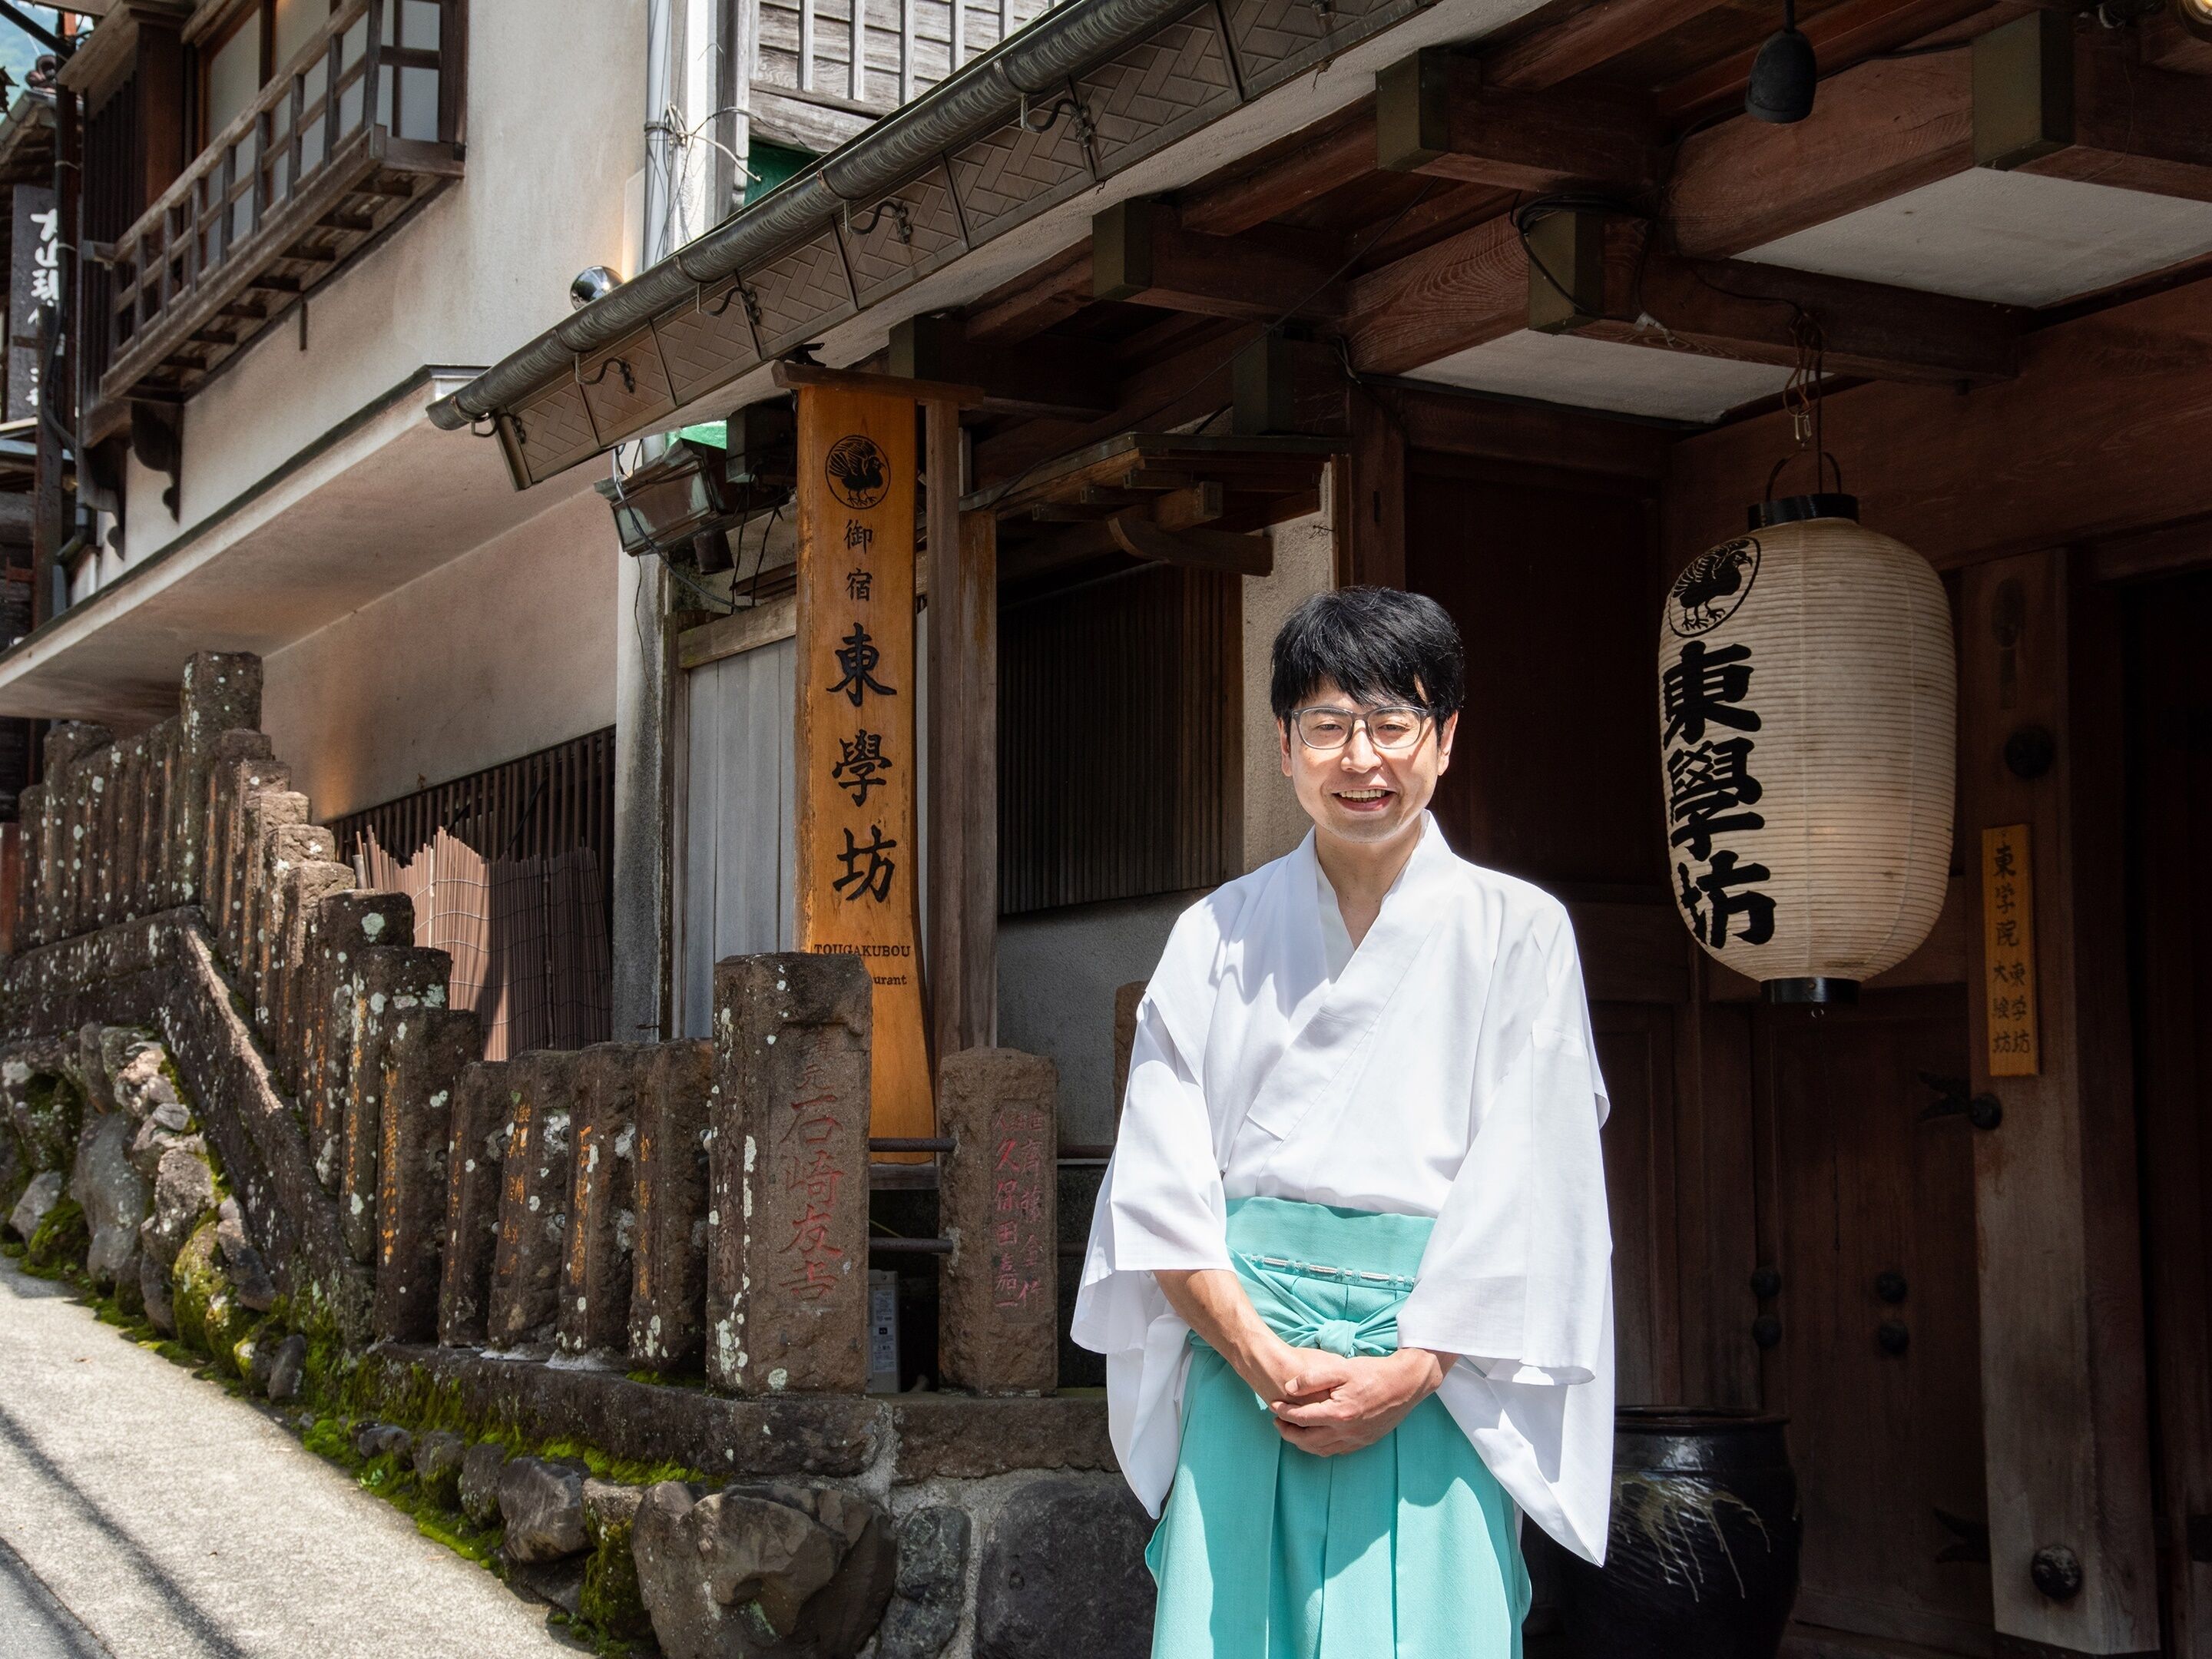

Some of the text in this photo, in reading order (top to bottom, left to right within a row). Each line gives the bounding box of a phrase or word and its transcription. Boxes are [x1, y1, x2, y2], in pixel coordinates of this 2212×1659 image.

[843, 518, 874, 602] 御宿
[826, 622, 898, 903] 東學坊
[1662, 640, 1777, 949] 東學坊
[813, 944, 911, 957] TOUGAKUBOU
